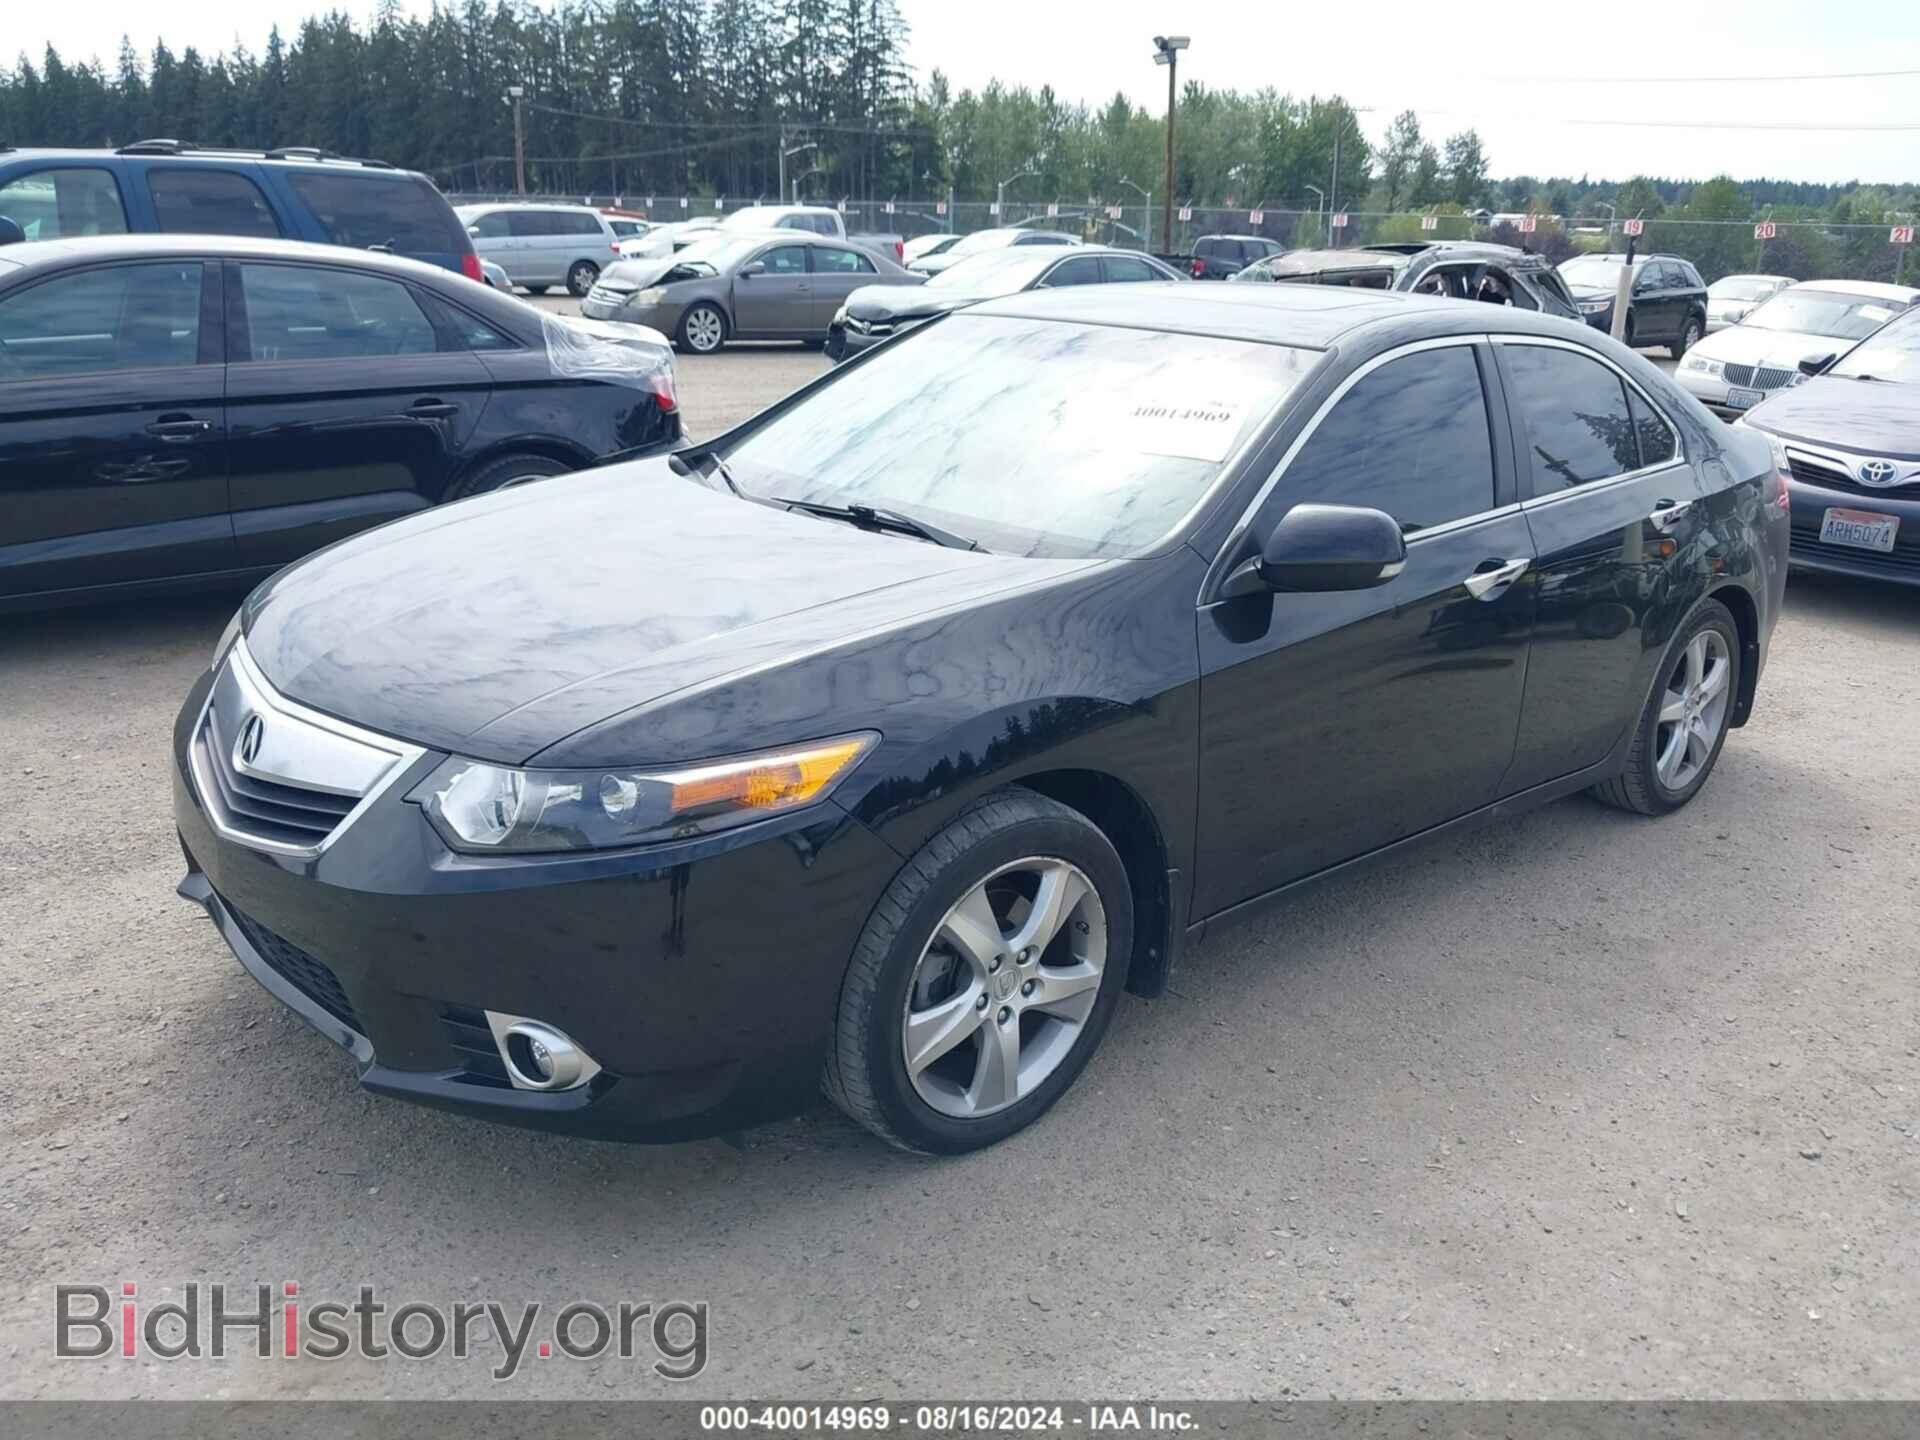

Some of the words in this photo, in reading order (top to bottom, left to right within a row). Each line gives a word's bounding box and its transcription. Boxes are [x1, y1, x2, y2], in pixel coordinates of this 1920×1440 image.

[1628, 221, 1640, 233] 19
[1757, 224, 1774, 237] 20
[1895, 229, 1910, 241] 21
